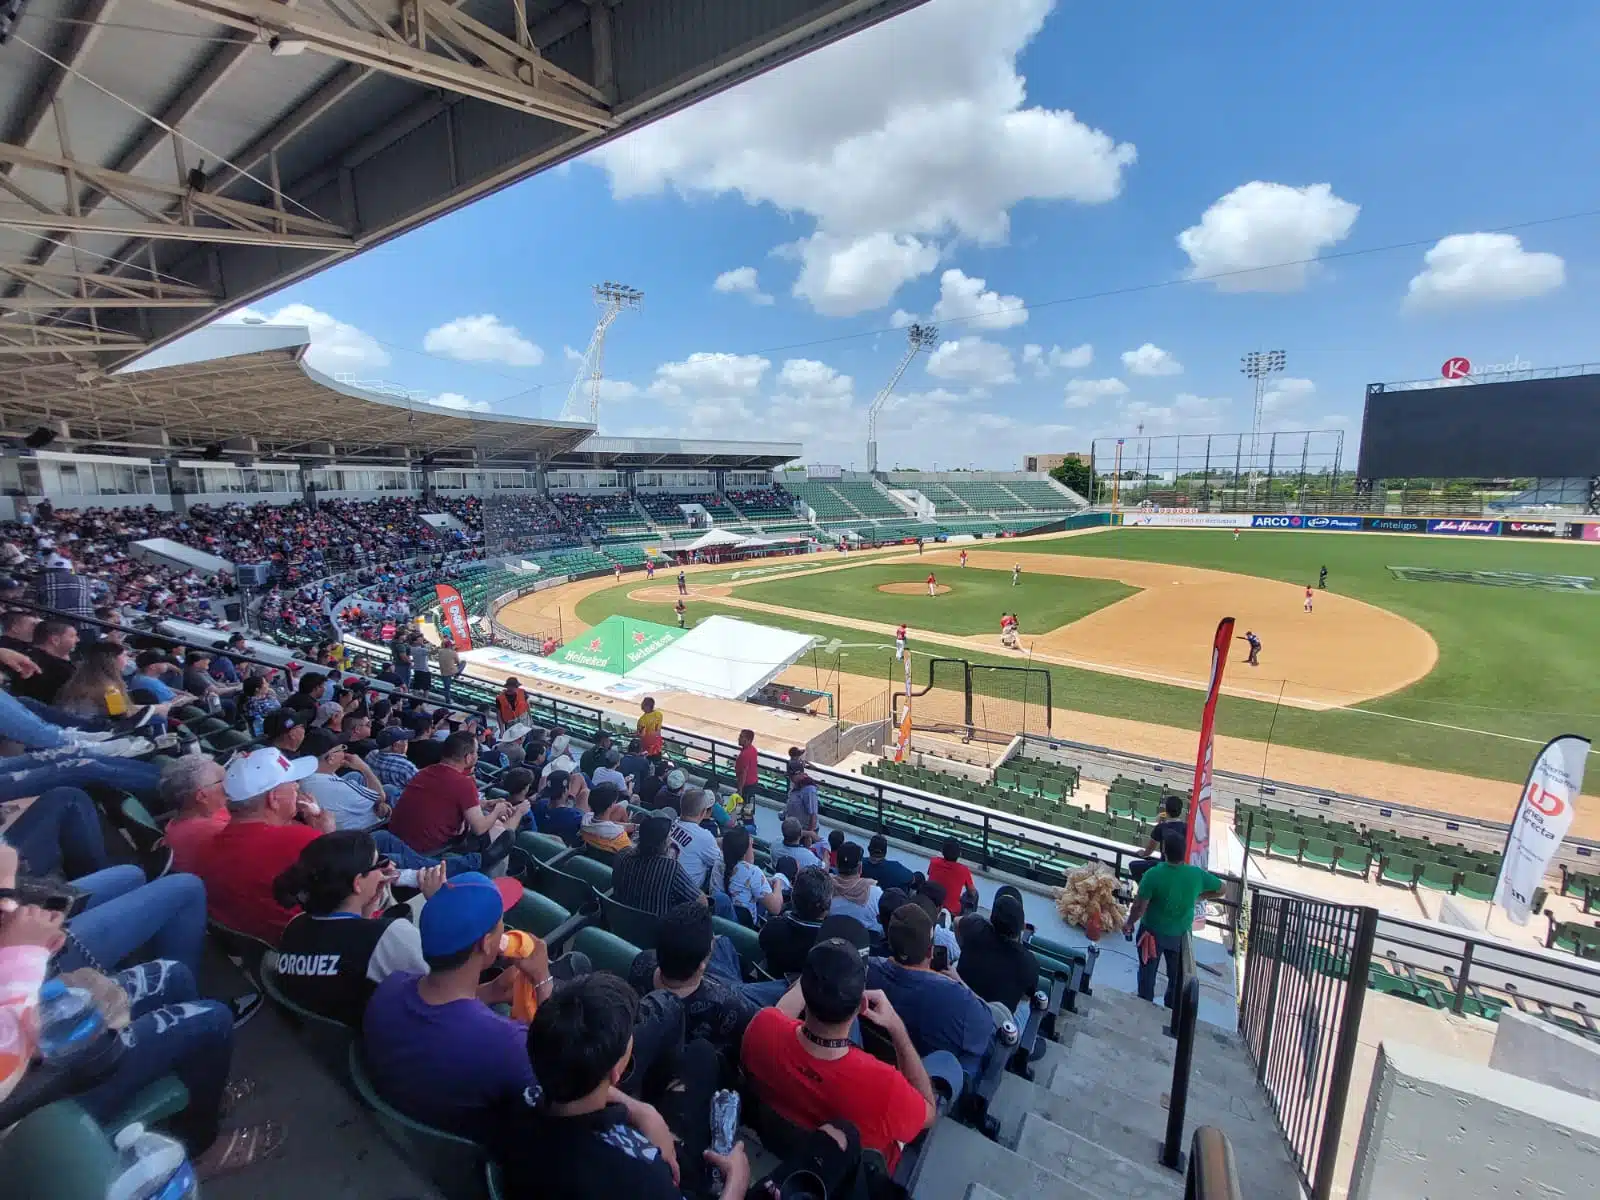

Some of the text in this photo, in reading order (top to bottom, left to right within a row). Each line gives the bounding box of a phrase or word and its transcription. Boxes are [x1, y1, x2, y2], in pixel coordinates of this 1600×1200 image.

[1255, 517, 1289, 527] ARCO
[627, 634, 675, 663] Heineken
[564, 650, 609, 668] Heineken
[514, 661, 586, 682] Chevron
